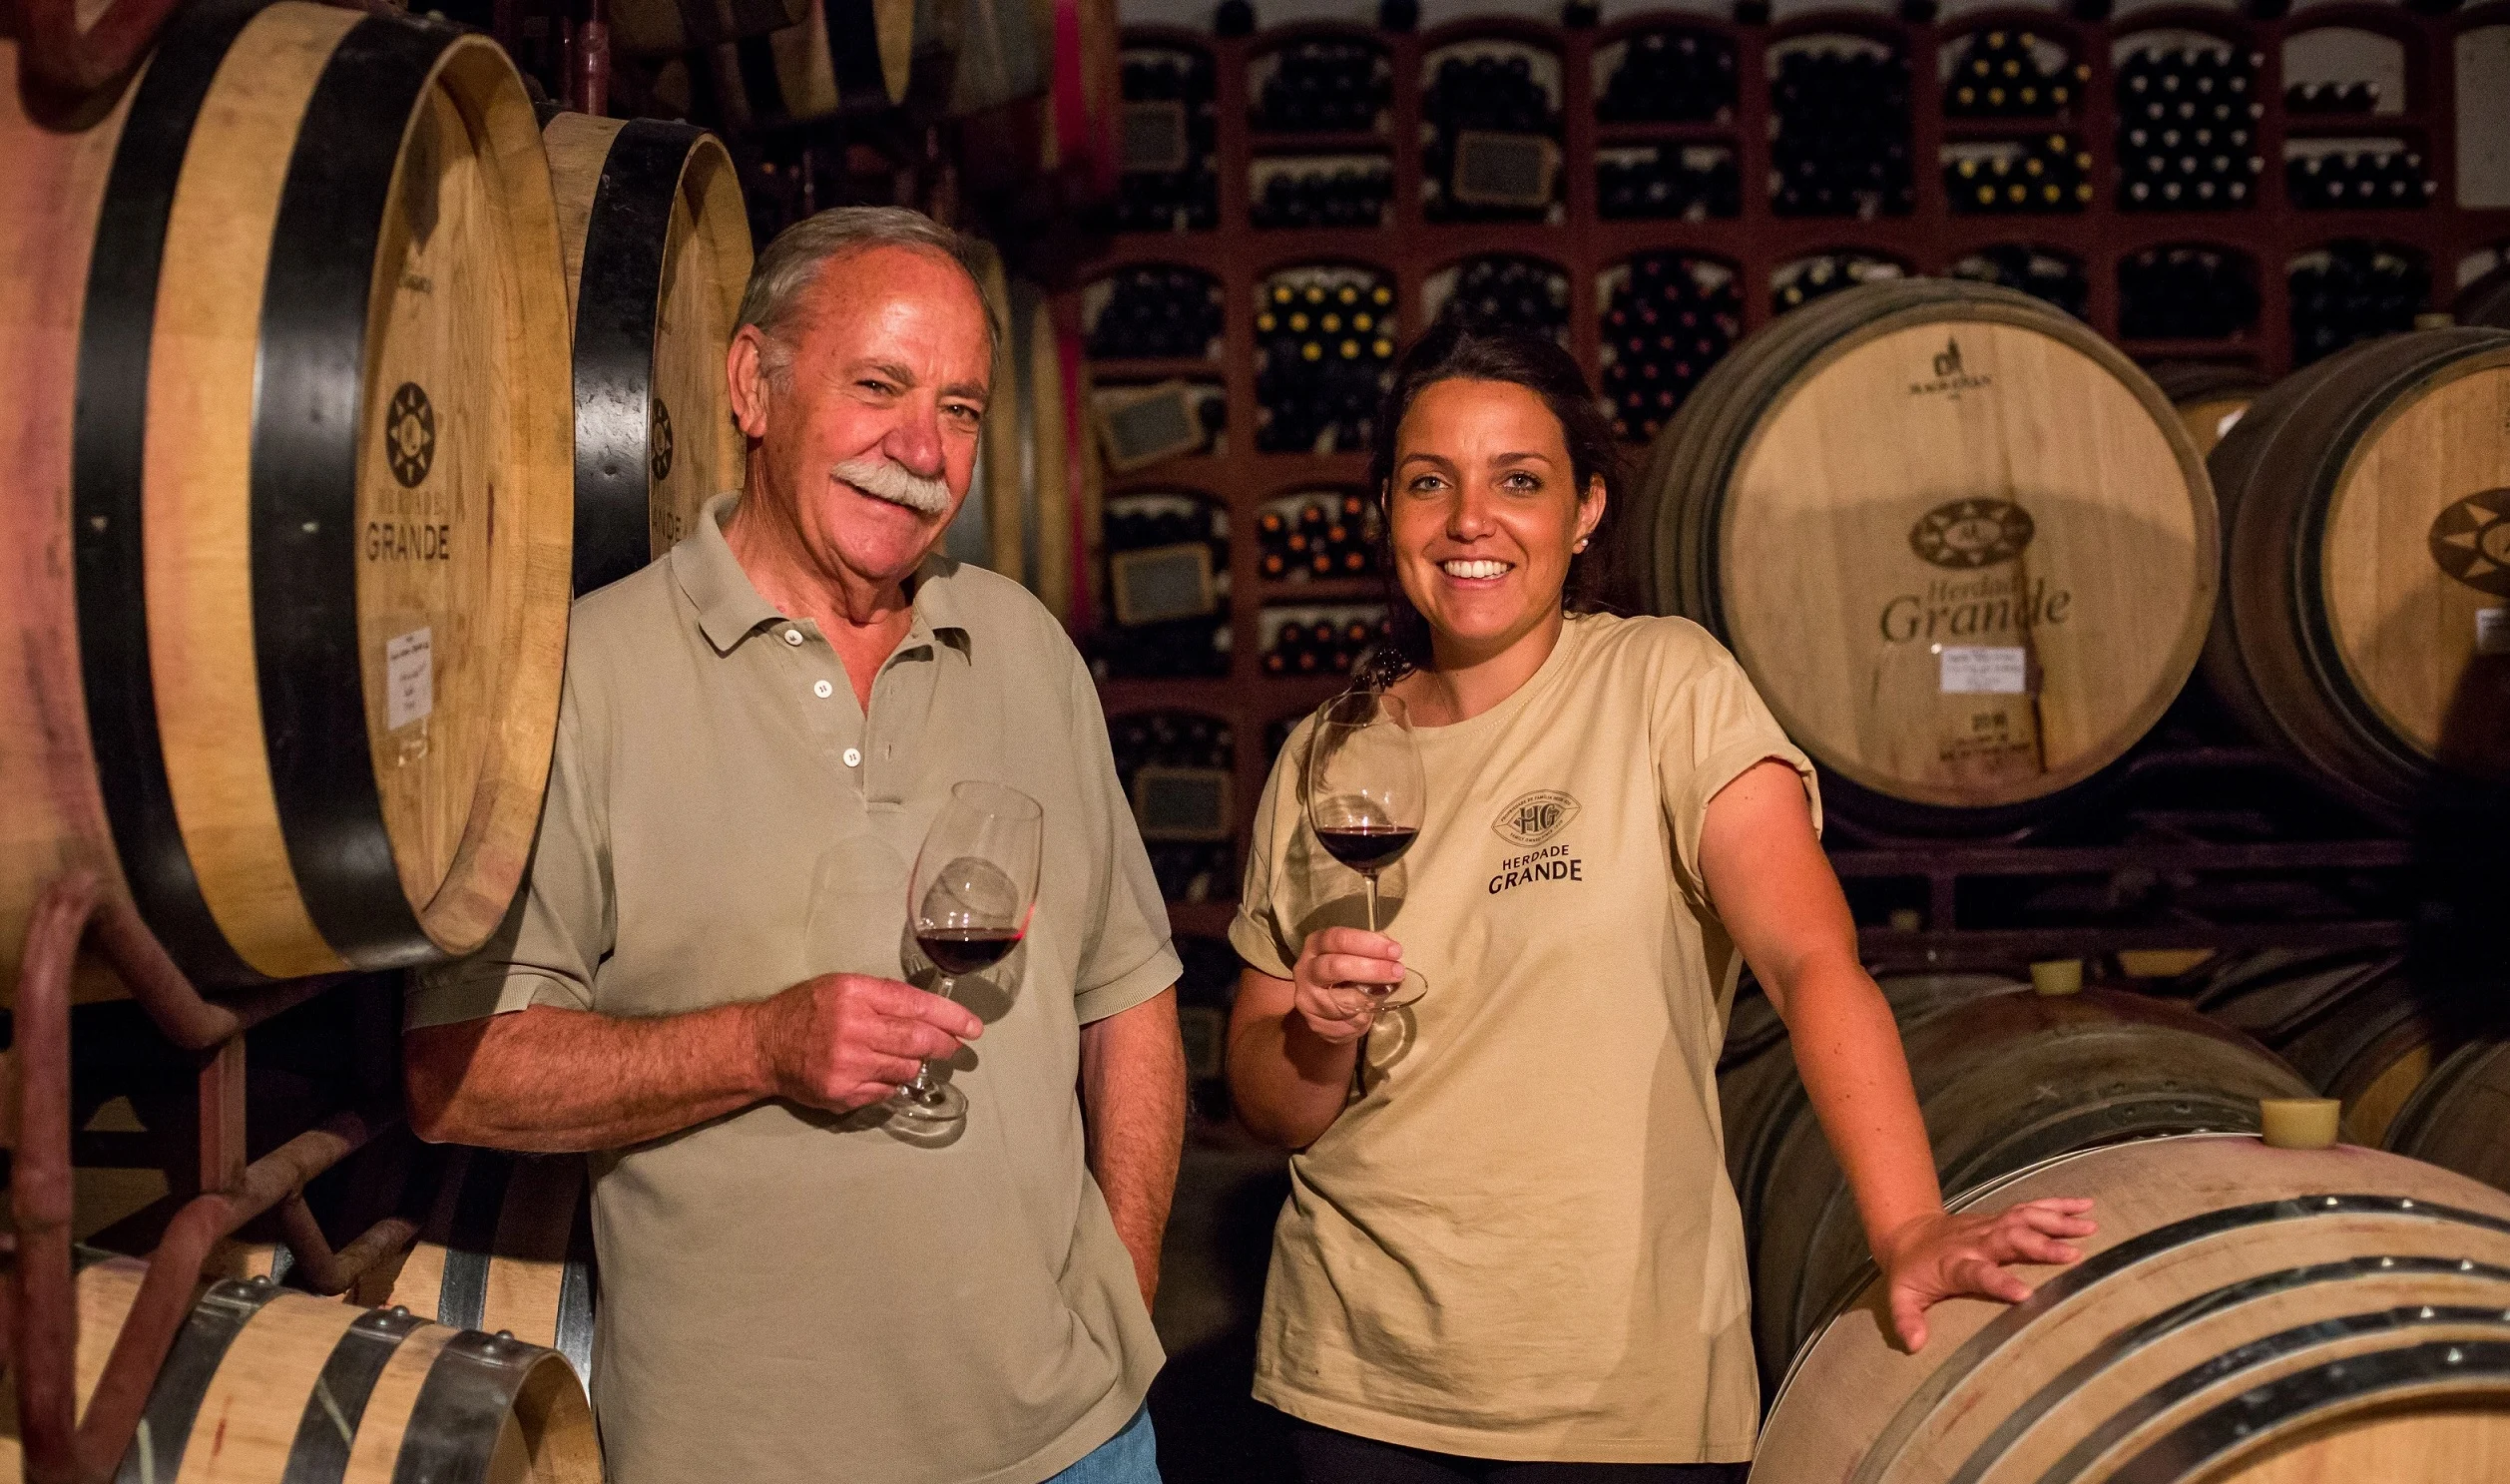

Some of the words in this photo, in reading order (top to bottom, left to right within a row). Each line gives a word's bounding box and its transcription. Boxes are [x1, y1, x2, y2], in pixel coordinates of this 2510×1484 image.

[366, 521, 450, 562] GRANDE
[1880, 577, 2072, 644] Grande
[1517, 802, 1558, 835] HG
[1502, 844, 1570, 871] HERDADE
[1488, 859, 1583, 895] GRANDE
